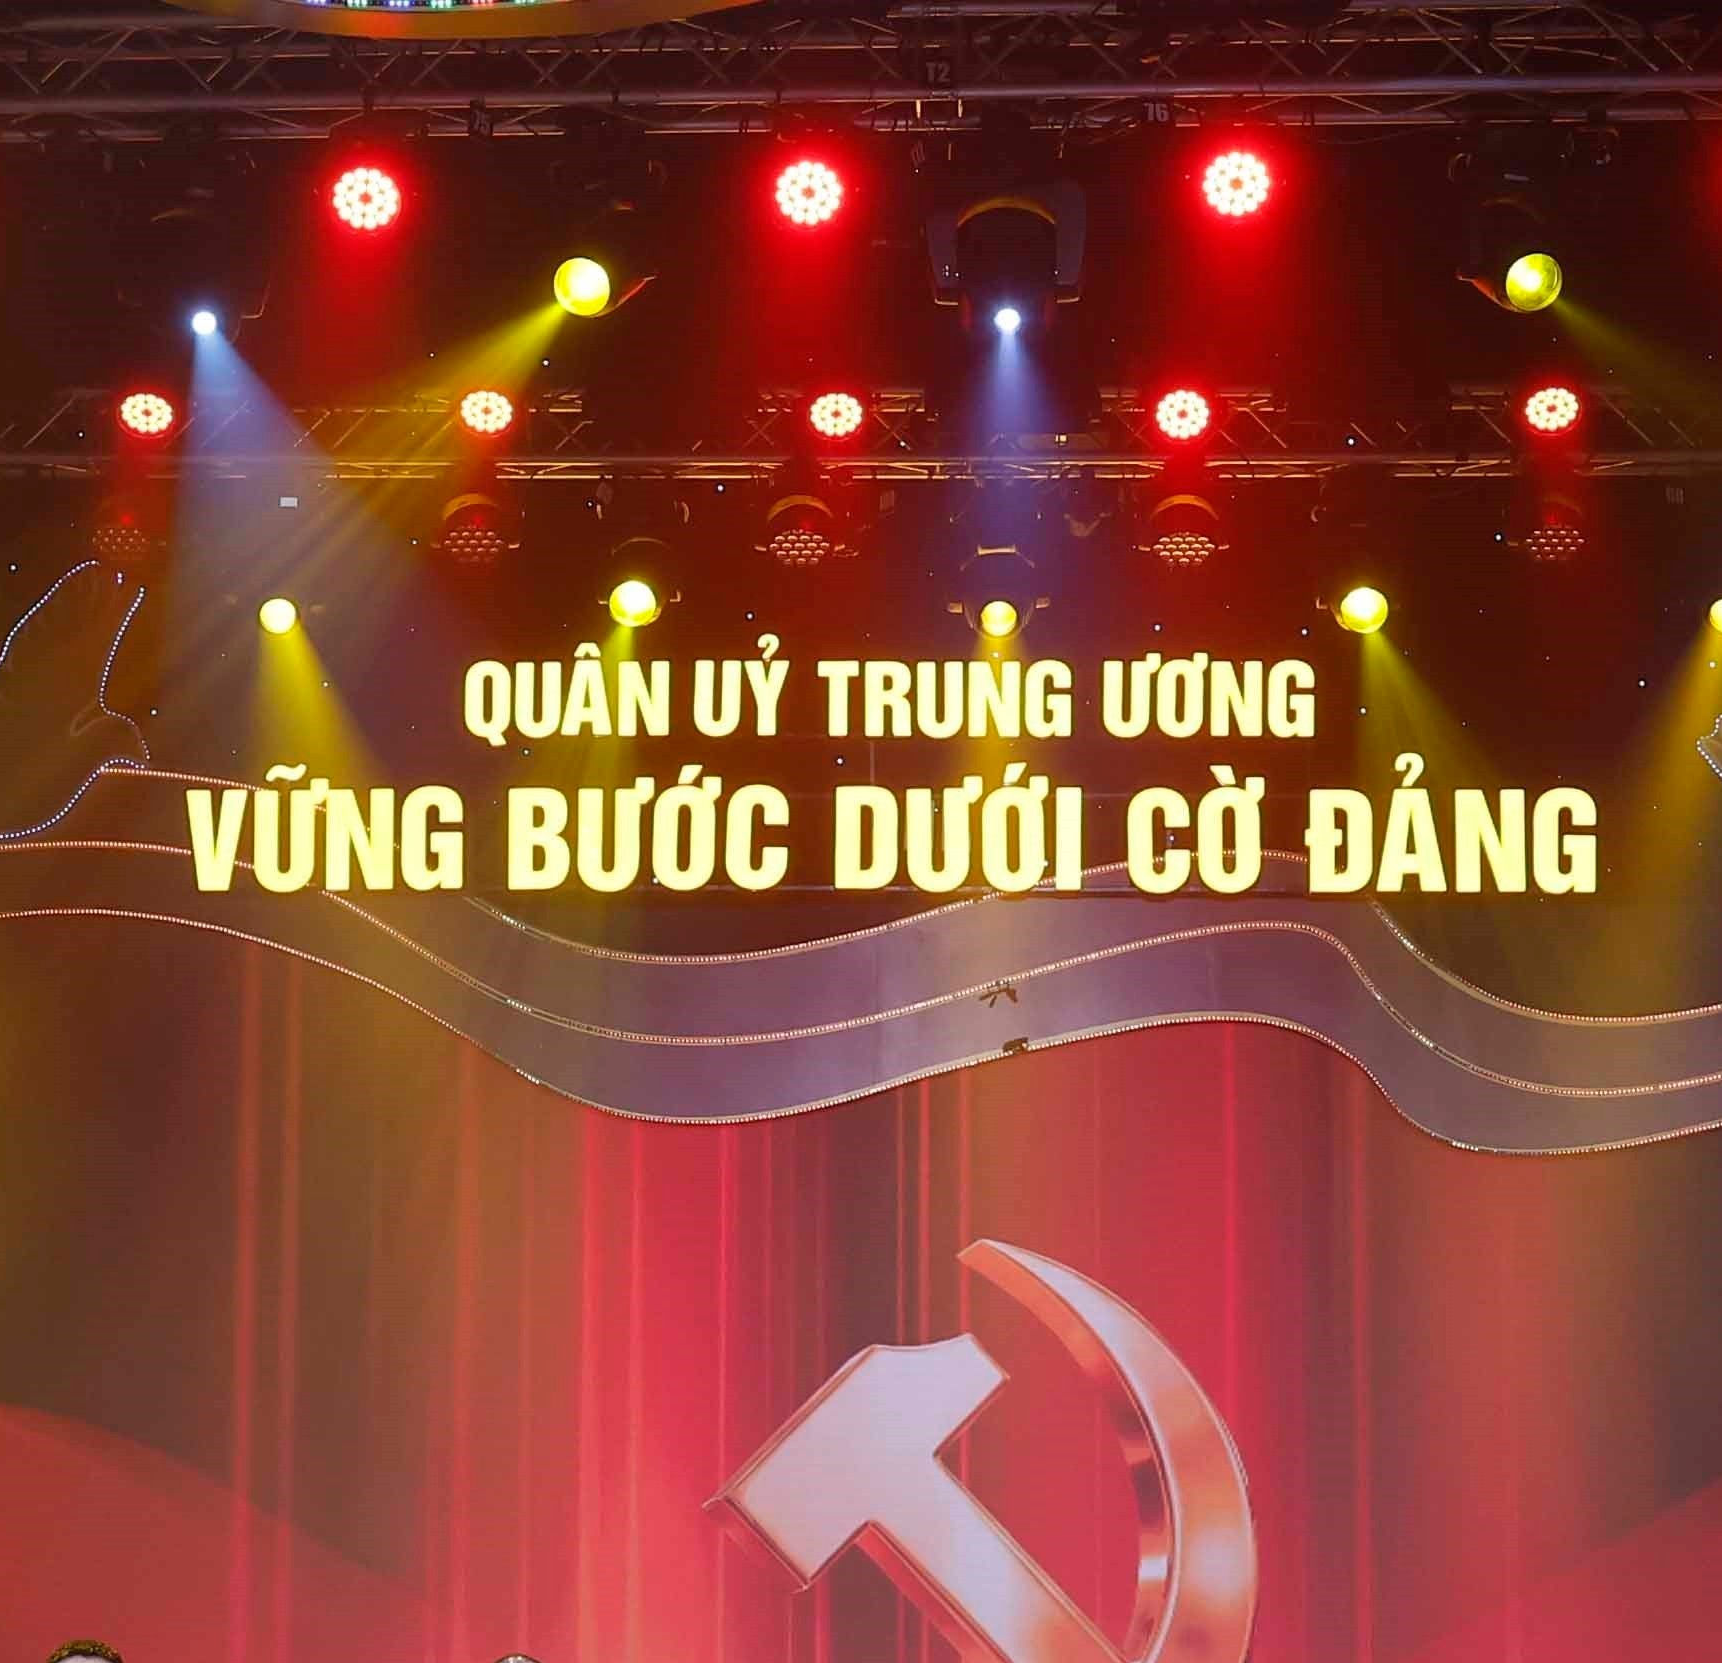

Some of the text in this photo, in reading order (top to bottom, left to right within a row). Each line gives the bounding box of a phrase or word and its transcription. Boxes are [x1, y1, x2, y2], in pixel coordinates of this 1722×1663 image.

[465, 634, 1314, 746] QUÂN UỶ TRUNG ƯƠNG
[187, 753, 1597, 893] VỮNG BƯỚC DƯỚI CỜ ĐẢNG
